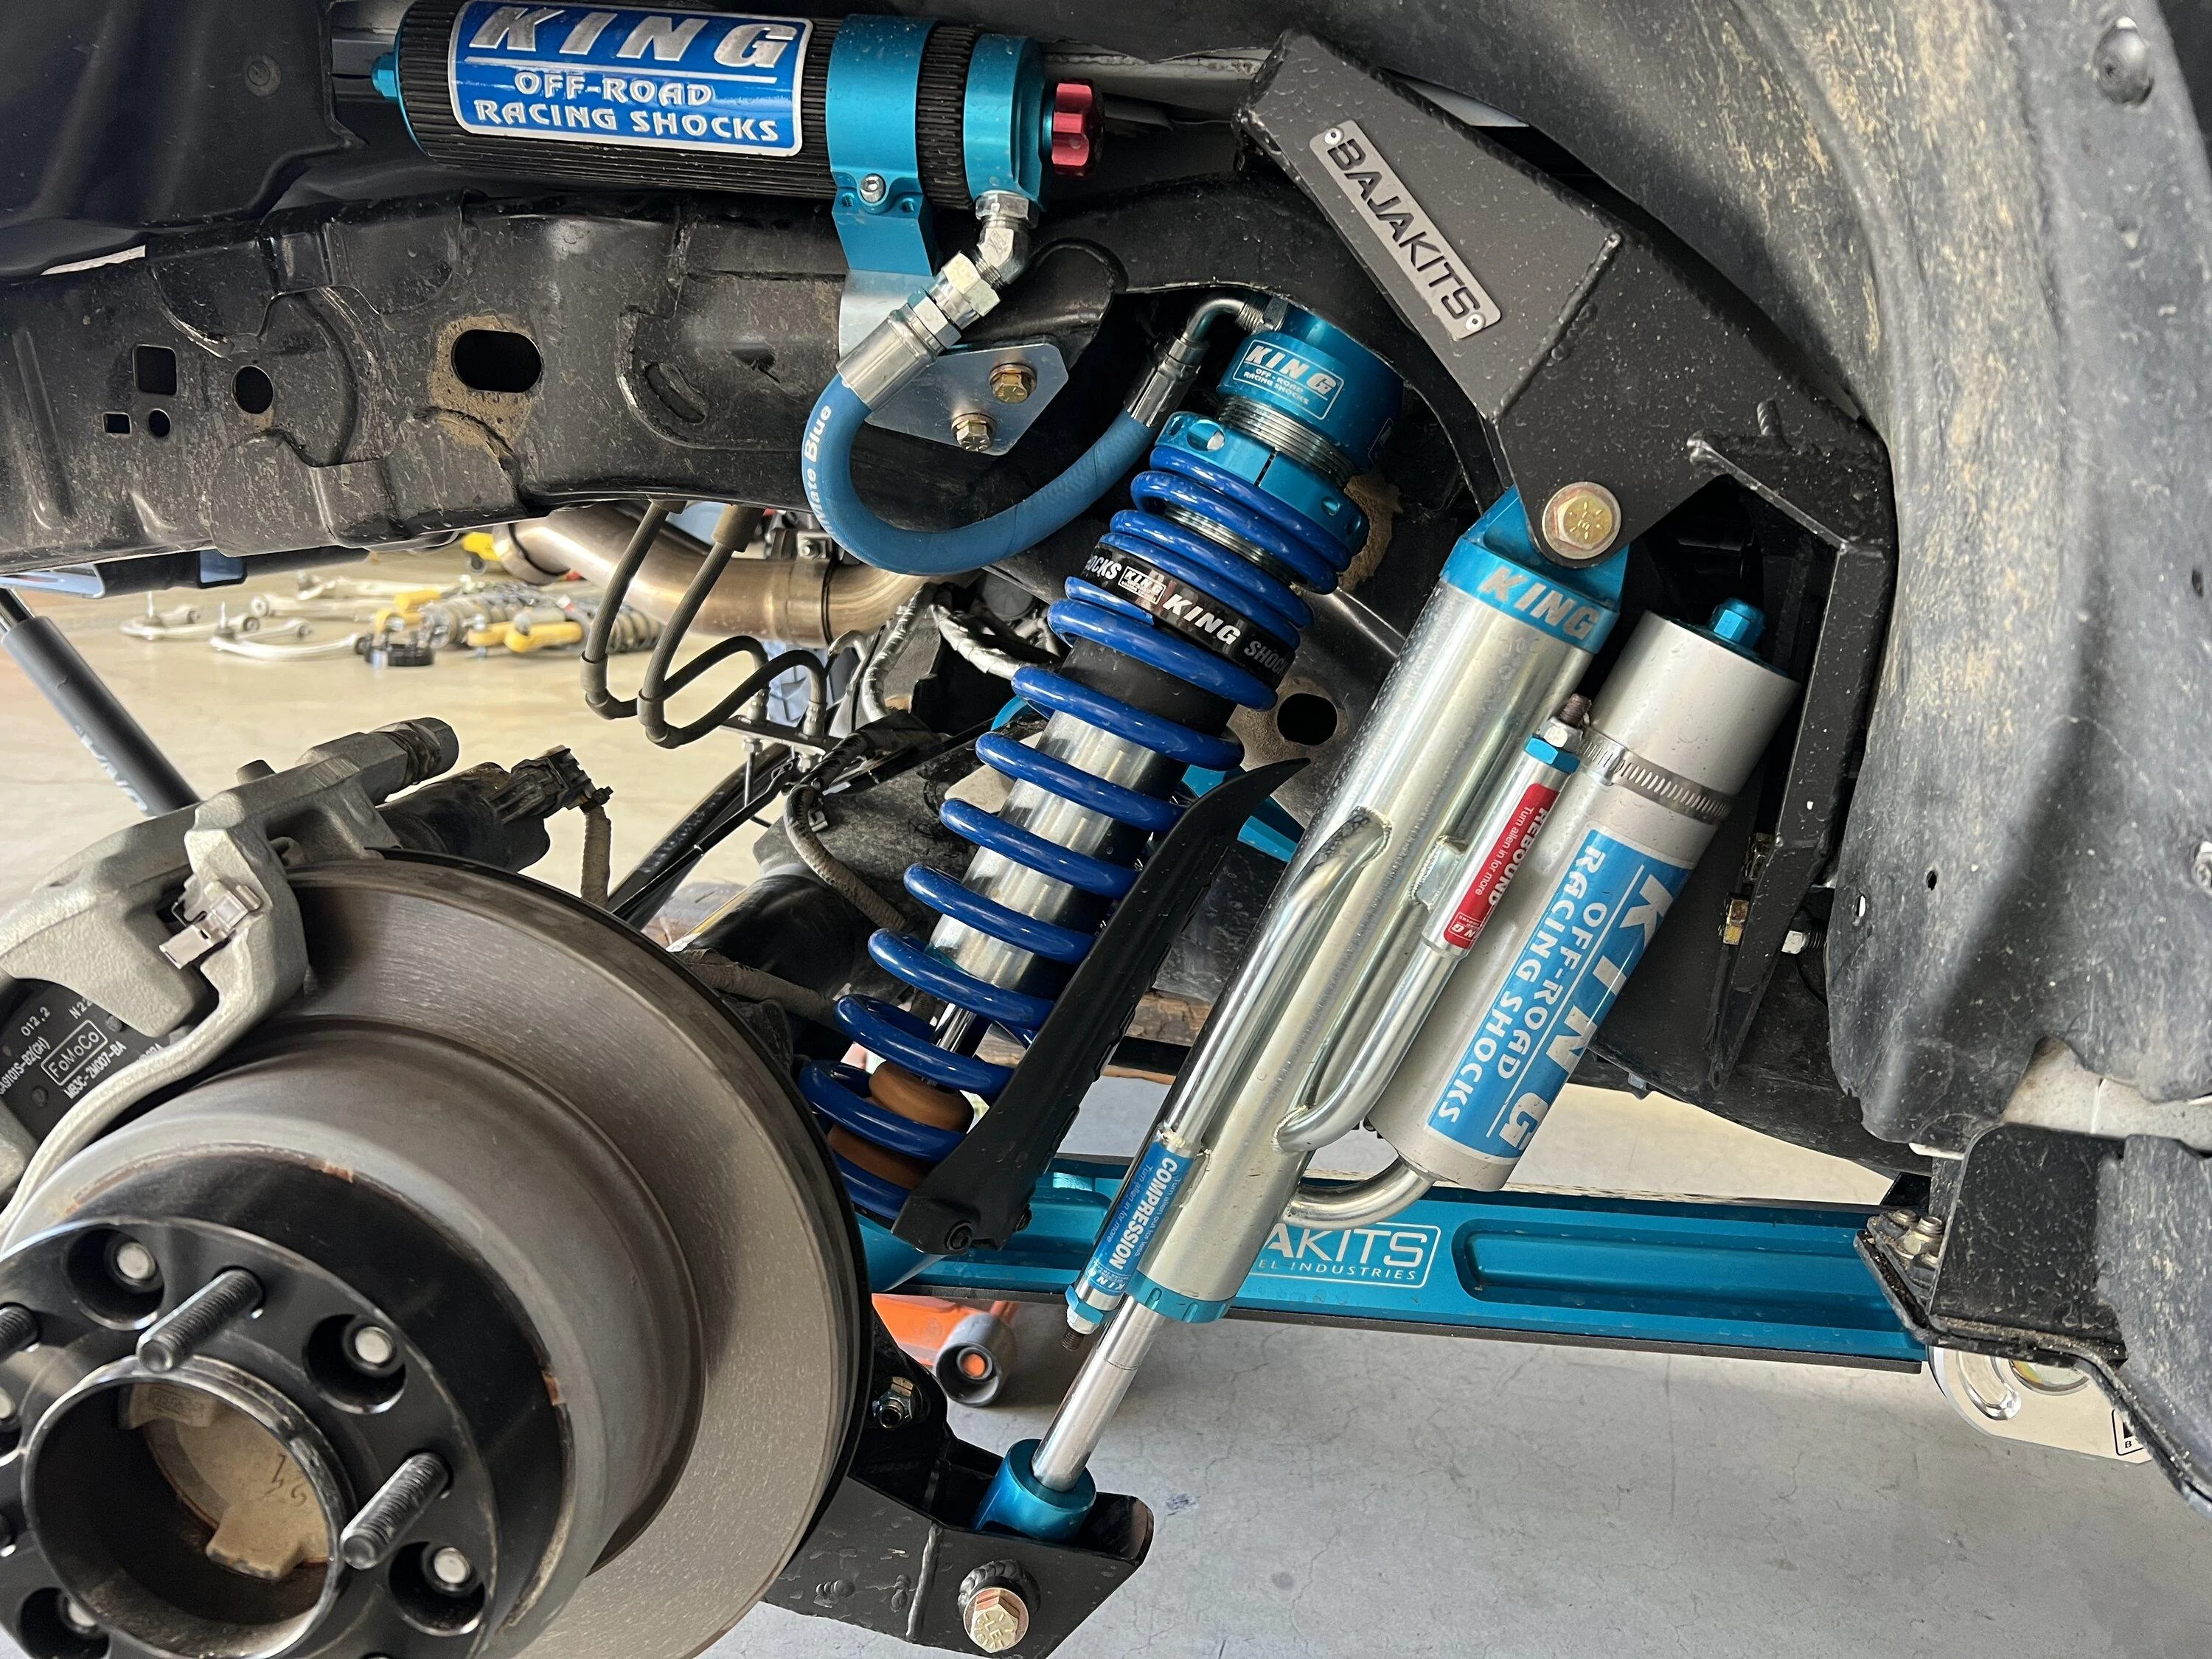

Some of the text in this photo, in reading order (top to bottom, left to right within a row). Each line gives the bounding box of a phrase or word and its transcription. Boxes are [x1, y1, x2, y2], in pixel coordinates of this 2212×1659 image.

[469, 6, 797, 68] KING
[515, 72, 714, 107] OFF-ROAD
[474, 100, 779, 143] RACING SHOCKS
[1327, 139, 1481, 319] BAJAKITS
[1243, 371, 1273, 387] RACING
[1245, 345, 1337, 395] KING
[1124, 570, 1164, 596] KING
[1477, 566, 1600, 640] KING
[1162, 594, 1241, 645] KING
[1489, 807, 1550, 905] REBOUND
[1496, 849, 1508, 859] in
[1502, 827, 1519, 849] allen
[1475, 872, 1492, 896] more
[1489, 859, 1503, 873] for
[1439, 845, 1606, 1124] RACING SHOCKS
[1498, 902, 1607, 1079] OFF-ROAD
[1498, 874, 1674, 1152] KING
[48, 1031, 100, 1079] FoMoCo
[1107, 1221, 1120, 1242] more
[1109, 1157, 1178, 1270] COMPRESSION
[1290, 1262, 1416, 1280] INDUSTRIES
